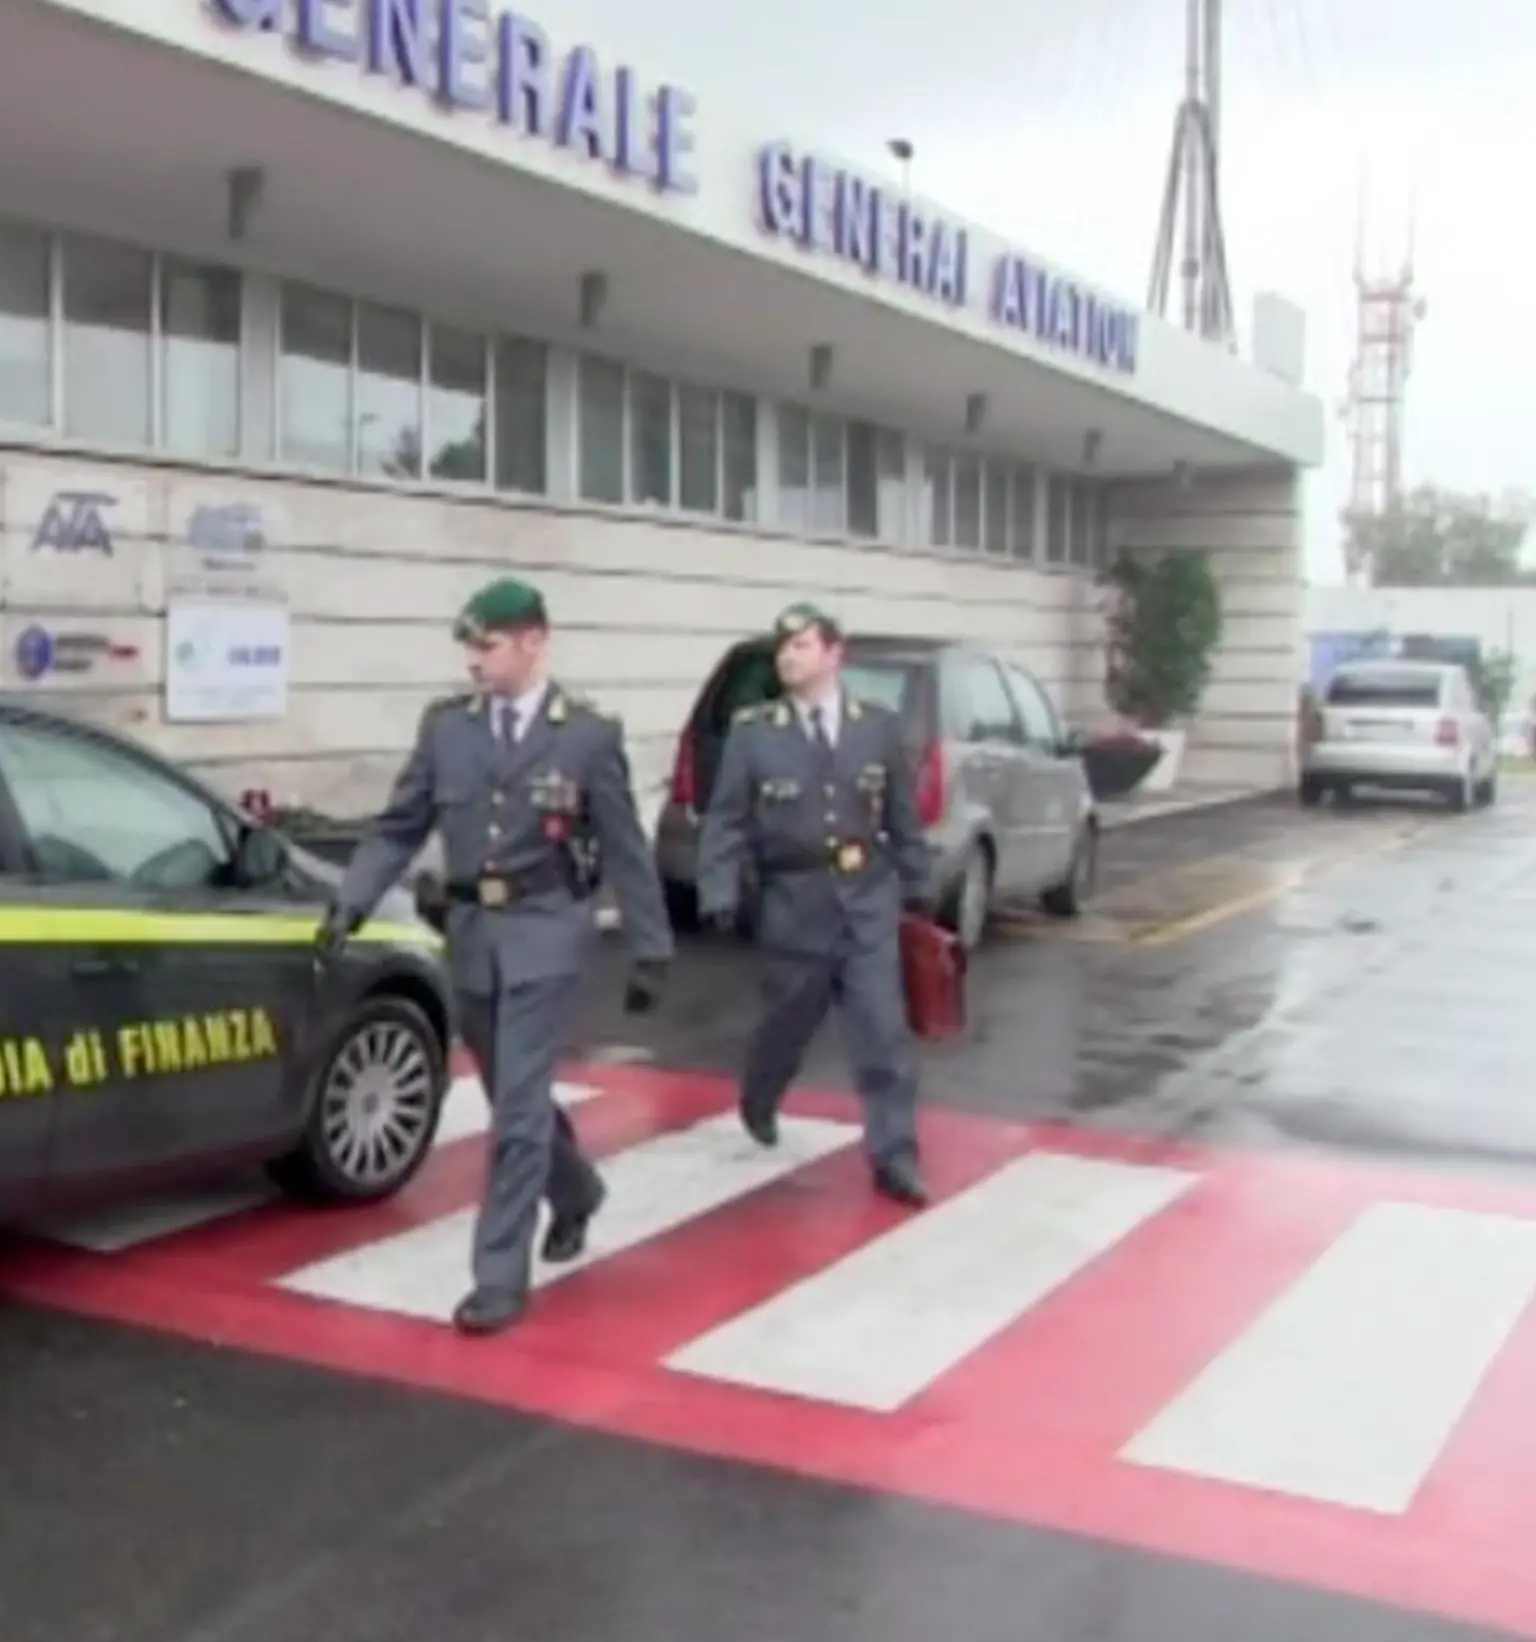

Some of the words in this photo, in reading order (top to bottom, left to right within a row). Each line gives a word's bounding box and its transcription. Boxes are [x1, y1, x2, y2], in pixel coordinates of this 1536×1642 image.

[204, 0, 698, 194] ENERALE
[30, 491, 120, 557] ATA
[65, 1027, 107, 1086] di
[117, 1007, 277, 1079] FINANZA
